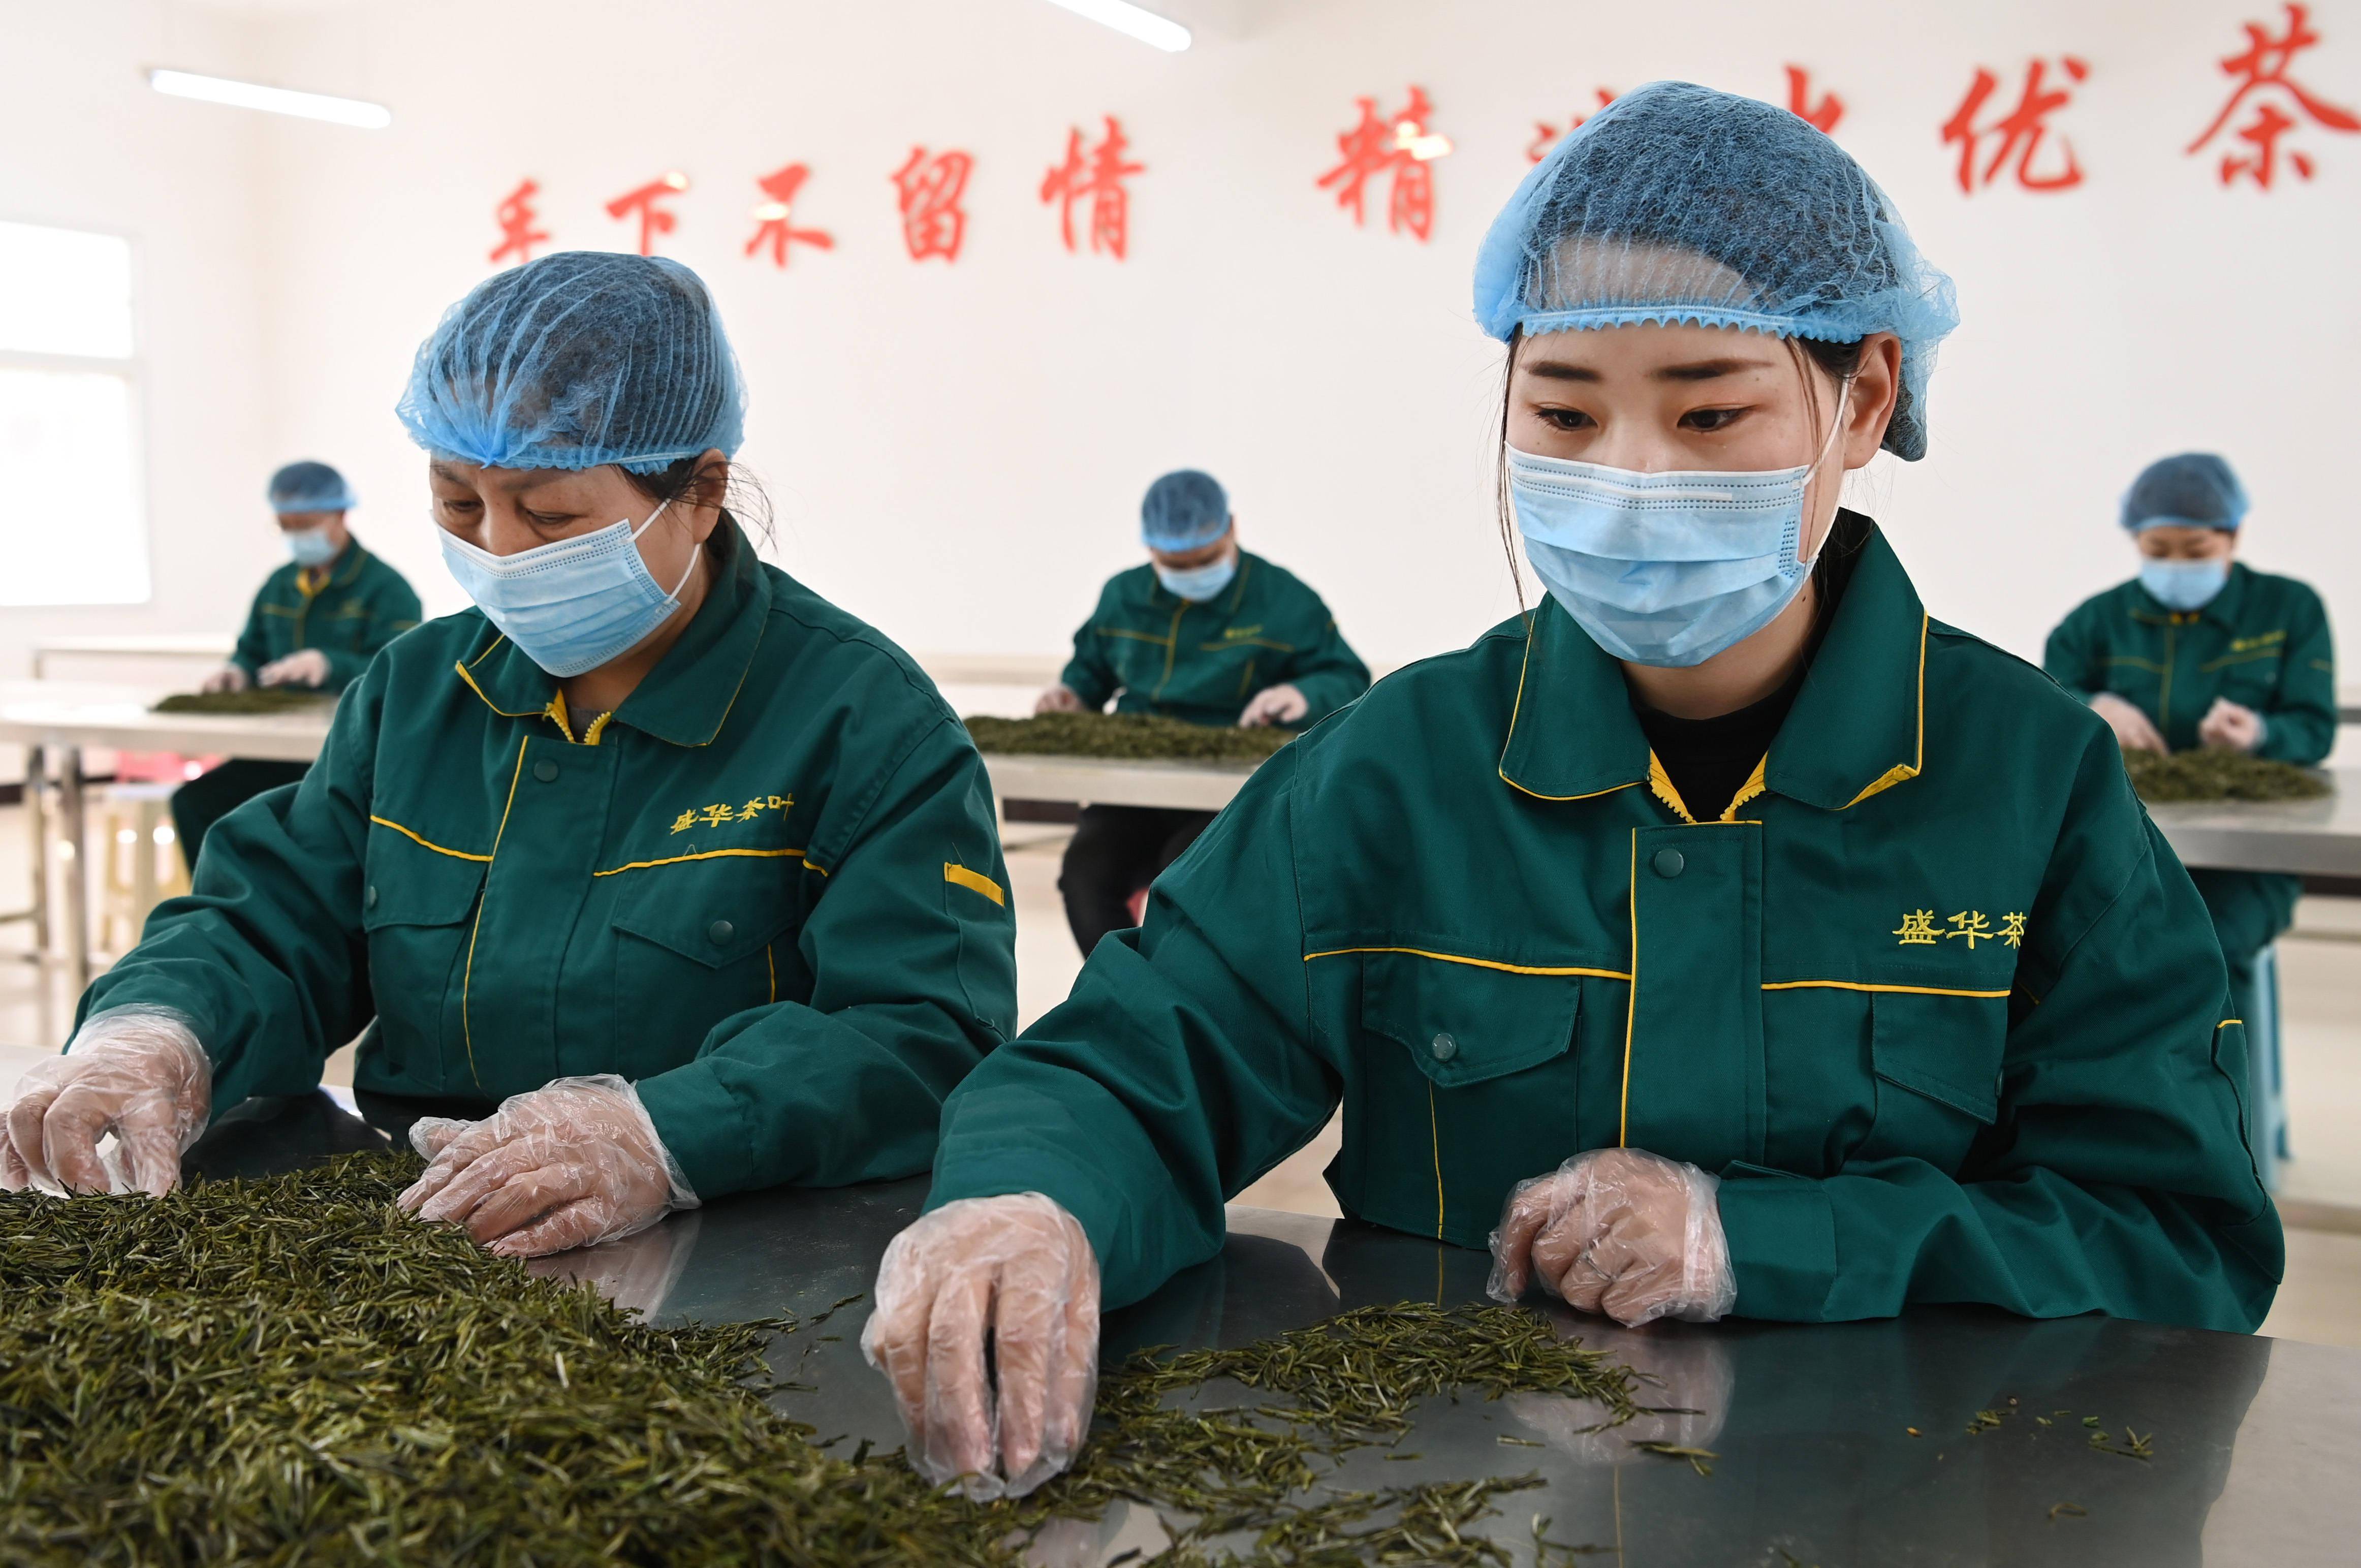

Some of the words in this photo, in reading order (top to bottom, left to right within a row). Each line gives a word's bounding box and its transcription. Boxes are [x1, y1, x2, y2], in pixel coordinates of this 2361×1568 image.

[1316, 2, 2361, 243] 精优茶
[670, 793, 795, 835] 盛华茶叶
[1892, 908, 2027, 949] 盛华茶
